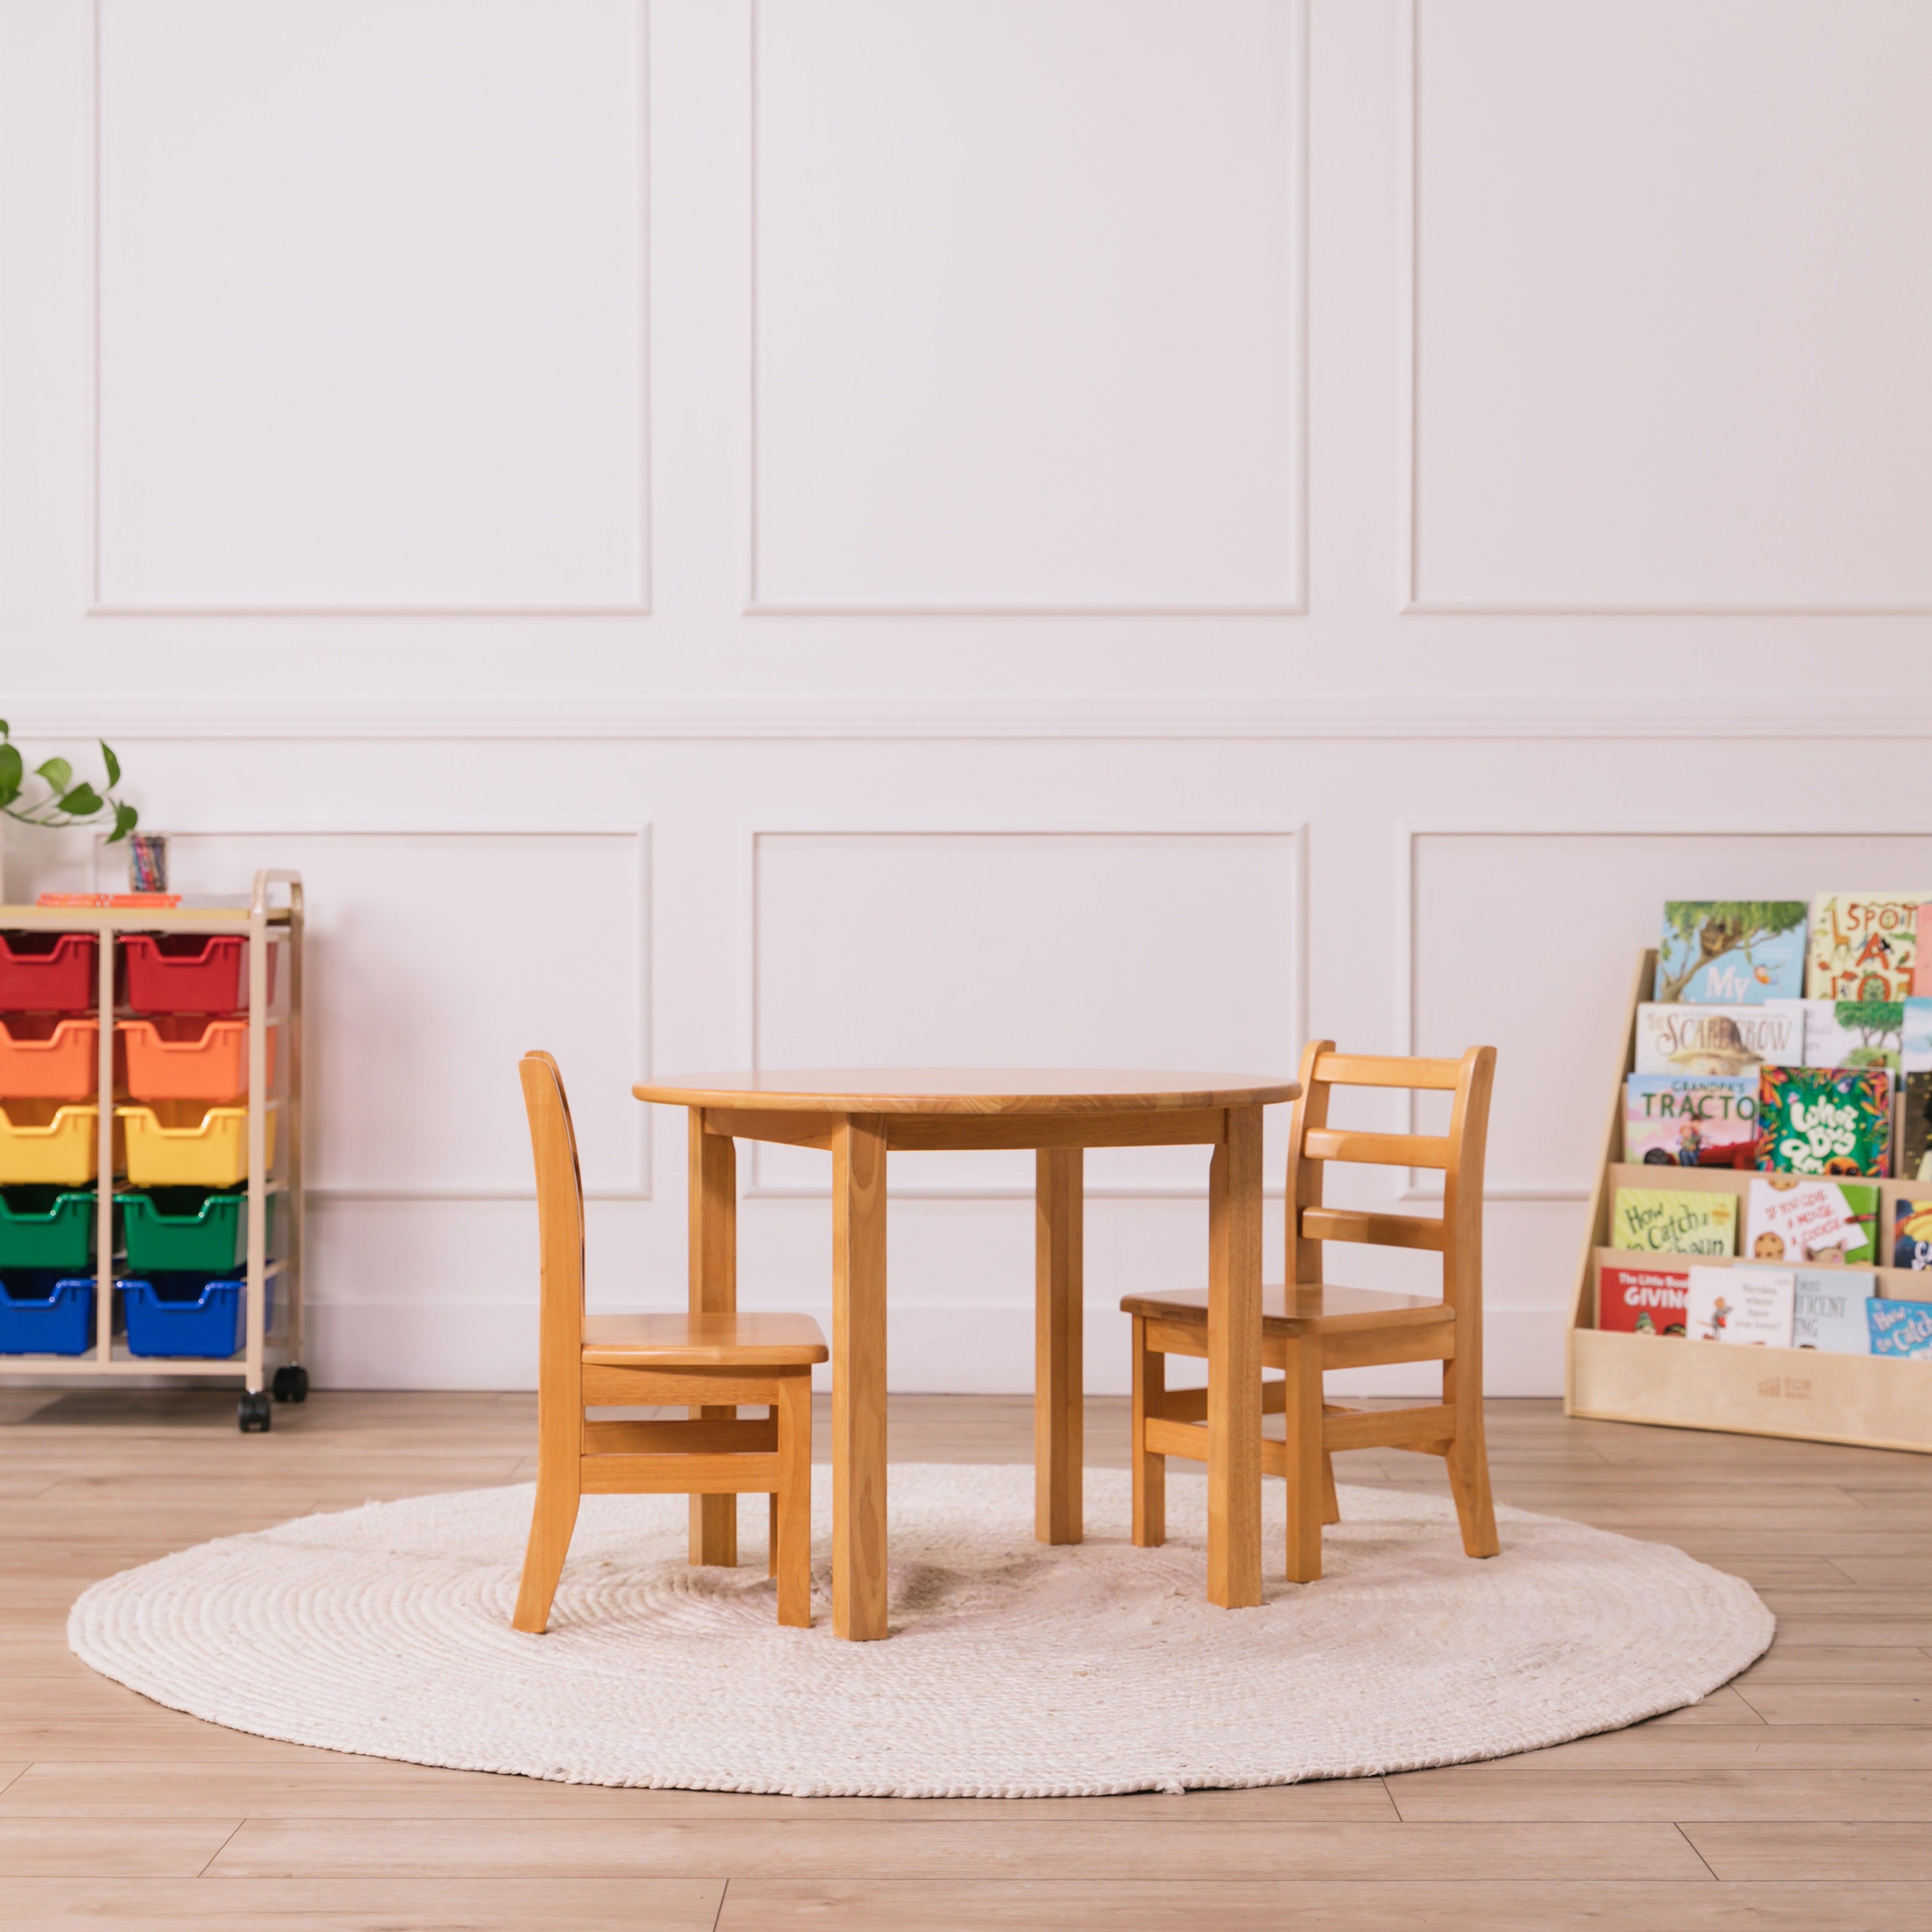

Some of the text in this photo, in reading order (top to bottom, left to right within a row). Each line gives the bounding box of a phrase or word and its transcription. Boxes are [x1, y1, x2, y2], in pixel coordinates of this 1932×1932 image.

[1847, 903, 1918, 932] SPOT
[1855, 933, 1889, 970] A
[1705, 966, 1750, 1003] My
[1790, 1094, 1859, 1133] What
[1625, 1203, 1664, 1235] How
[1648, 1204, 1699, 1249] Catch
[1619, 1272, 1637, 1285] The
[1665, 1276, 1689, 1289] Boo
[1874, 1307, 1906, 1332] How
